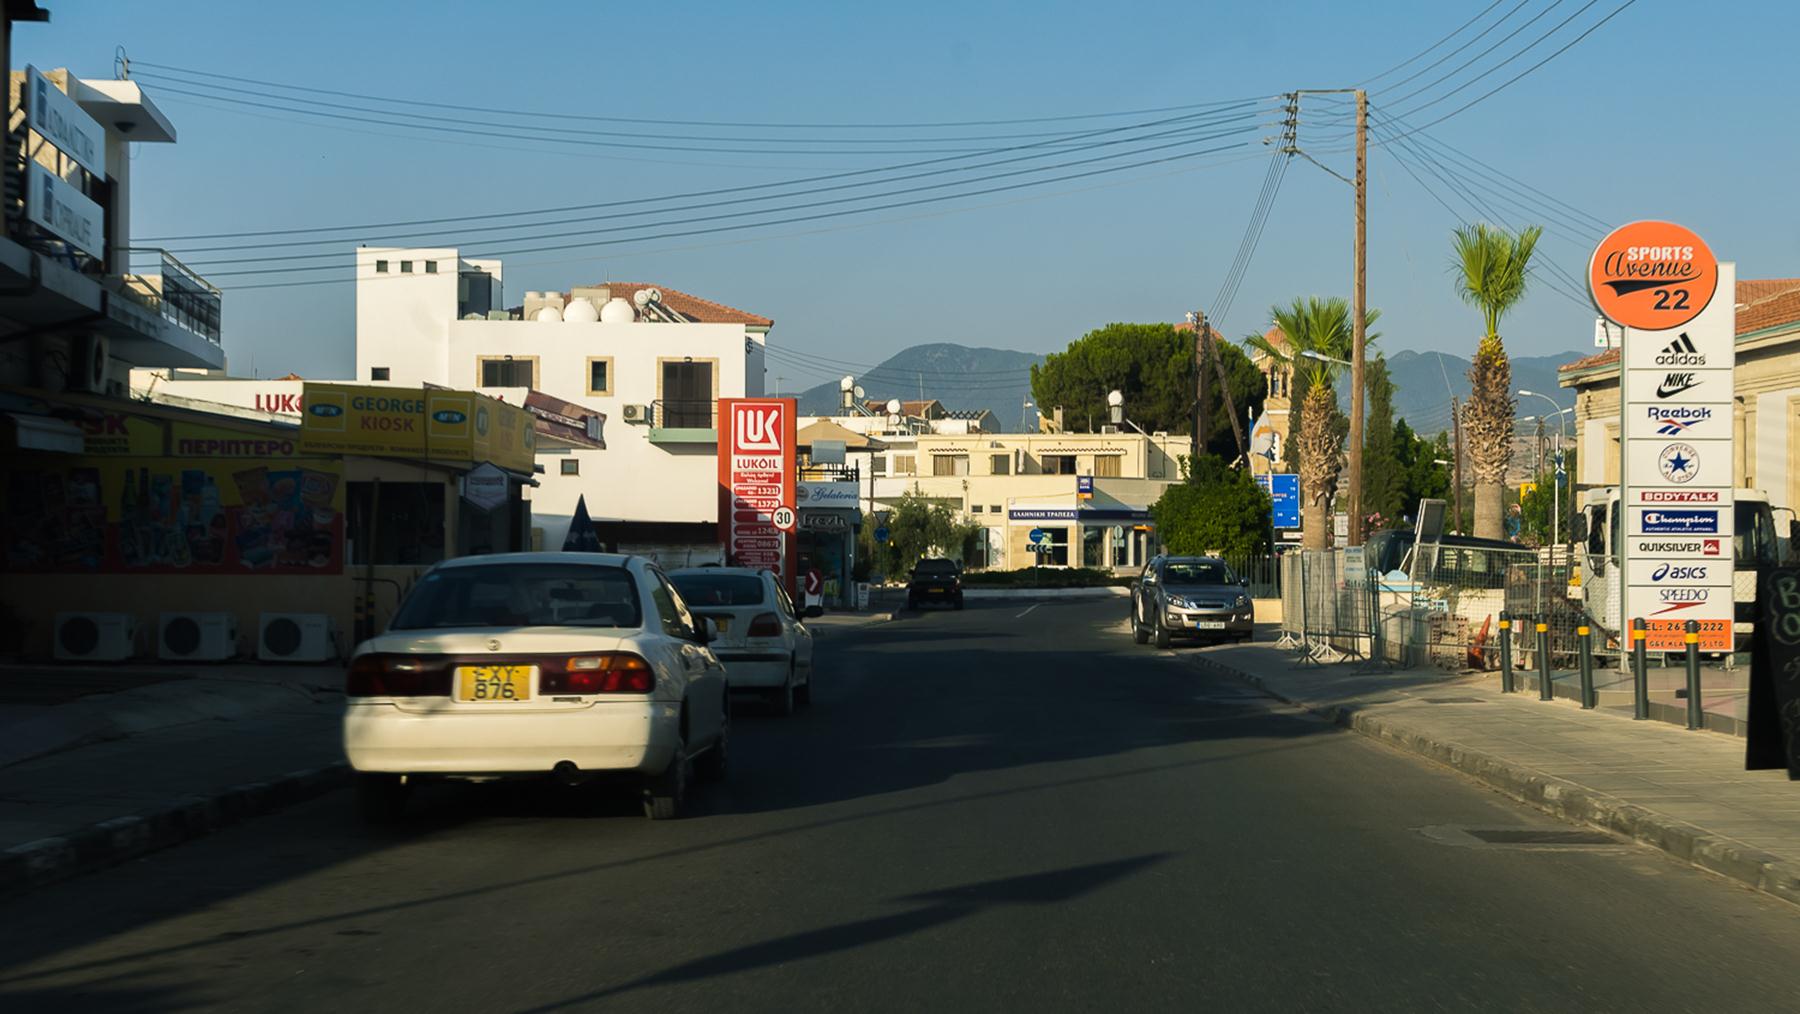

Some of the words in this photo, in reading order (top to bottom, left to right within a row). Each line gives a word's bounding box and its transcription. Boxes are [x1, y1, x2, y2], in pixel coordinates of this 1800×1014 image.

[1627, 246, 1694, 261] SPORTS
[1653, 289, 1690, 310] 22
[1655, 353, 1706, 365] adidas
[1663, 373, 1695, 387] NIKE
[352, 396, 425, 414] GEORGE
[1648, 407, 1711, 420] Reebok
[361, 416, 415, 432] KIOSK
[179, 438, 294, 455] ΠΕΡΙΠΤΕΡΟ
[737, 458, 778, 469] LUKOIL
[811, 487, 858, 501] Gelateria
[1644, 493, 1716, 501] BODYTALK
[776, 512, 791, 525] 30
[1645, 512, 1715, 528] Champion
[1639, 542, 1701, 552] QUIKSILVER
[1670, 567, 1706, 579] asics
[1660, 589, 1708, 601] SPEEDO
[475, 682, 514, 698] 876
